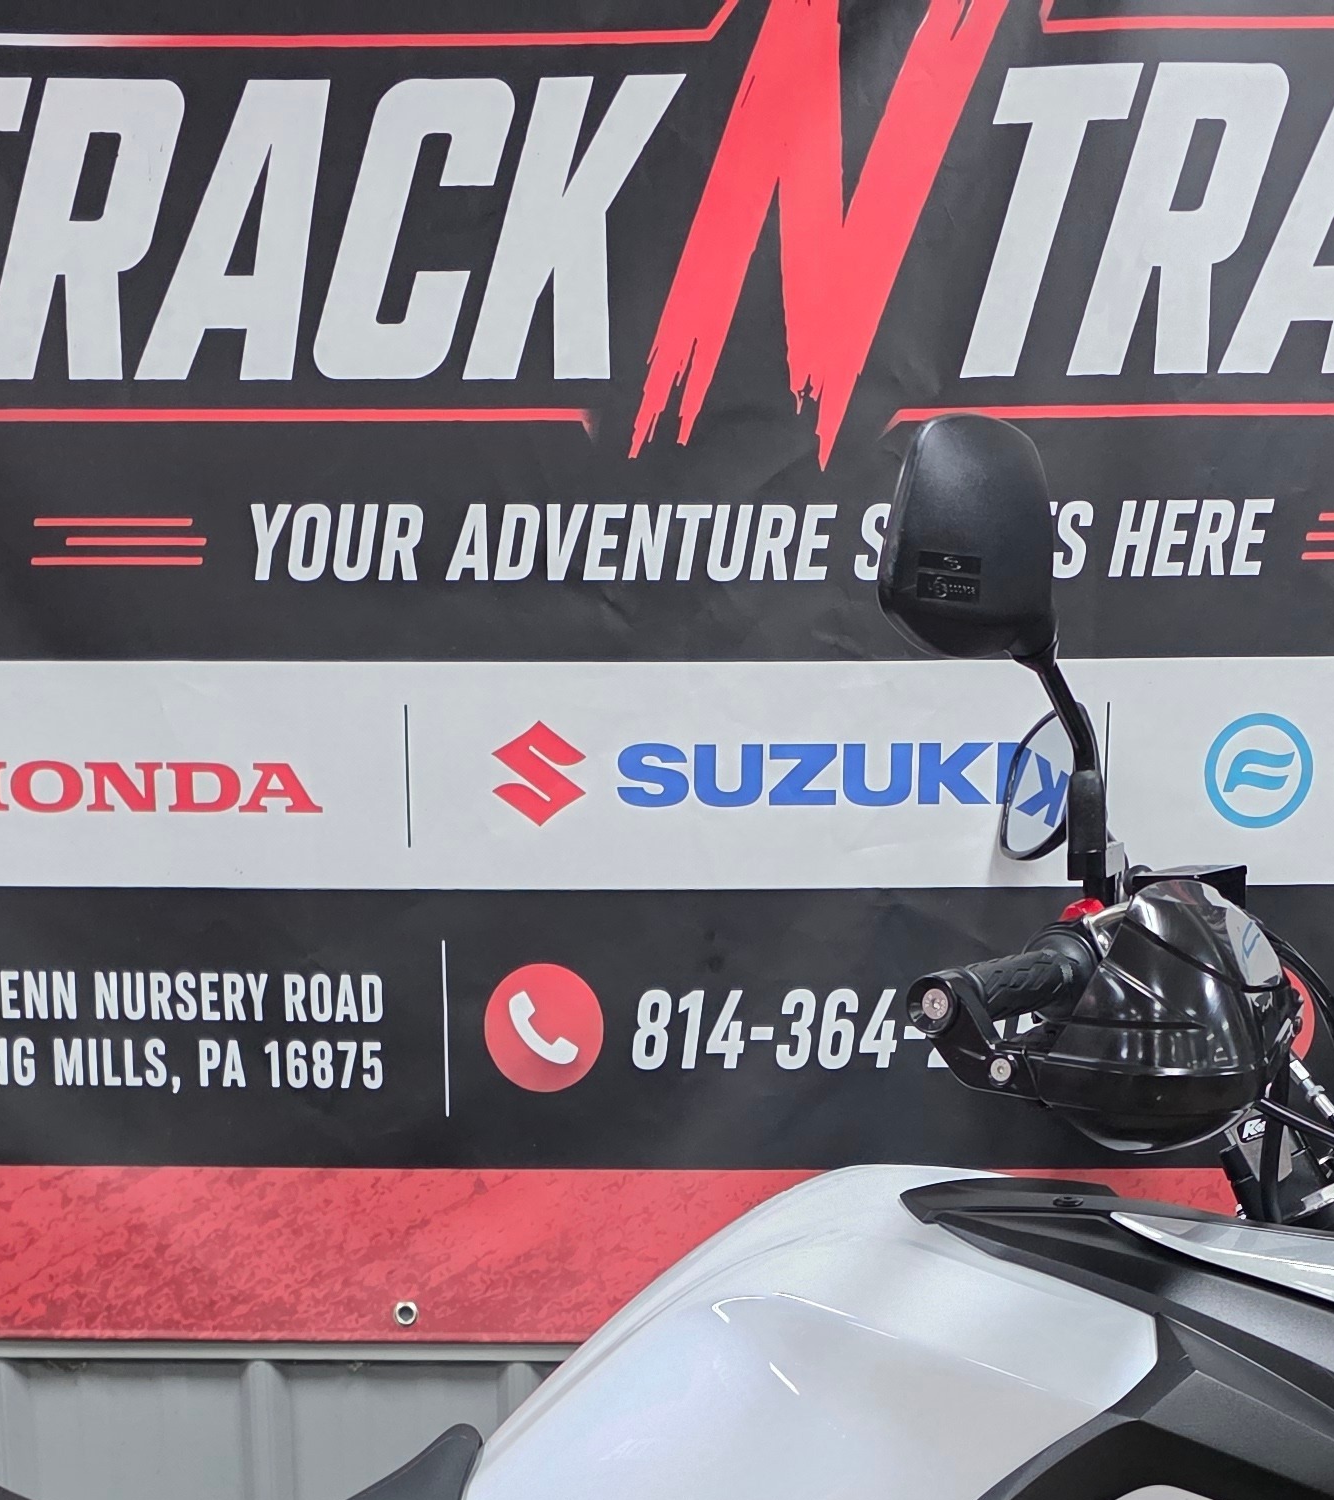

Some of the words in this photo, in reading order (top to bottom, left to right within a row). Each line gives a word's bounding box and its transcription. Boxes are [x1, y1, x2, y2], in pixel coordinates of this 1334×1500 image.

[628, 0, 1012, 472] N
[250, 503, 423, 582] YOUR
[445, 503, 837, 582] ADVENTURE
[1108, 498, 1275, 578] HERE
[617, 741, 1020, 808] SUZUKI
[94, 972, 268, 1022] NURSERY
[284, 974, 383, 1024] ROAD
[632, 988, 1042, 1070] 814-364-
[52, 1038, 181, 1094] MILLS,
[198, 1040, 246, 1088] PA
[264, 1042, 383, 1090] 16875
